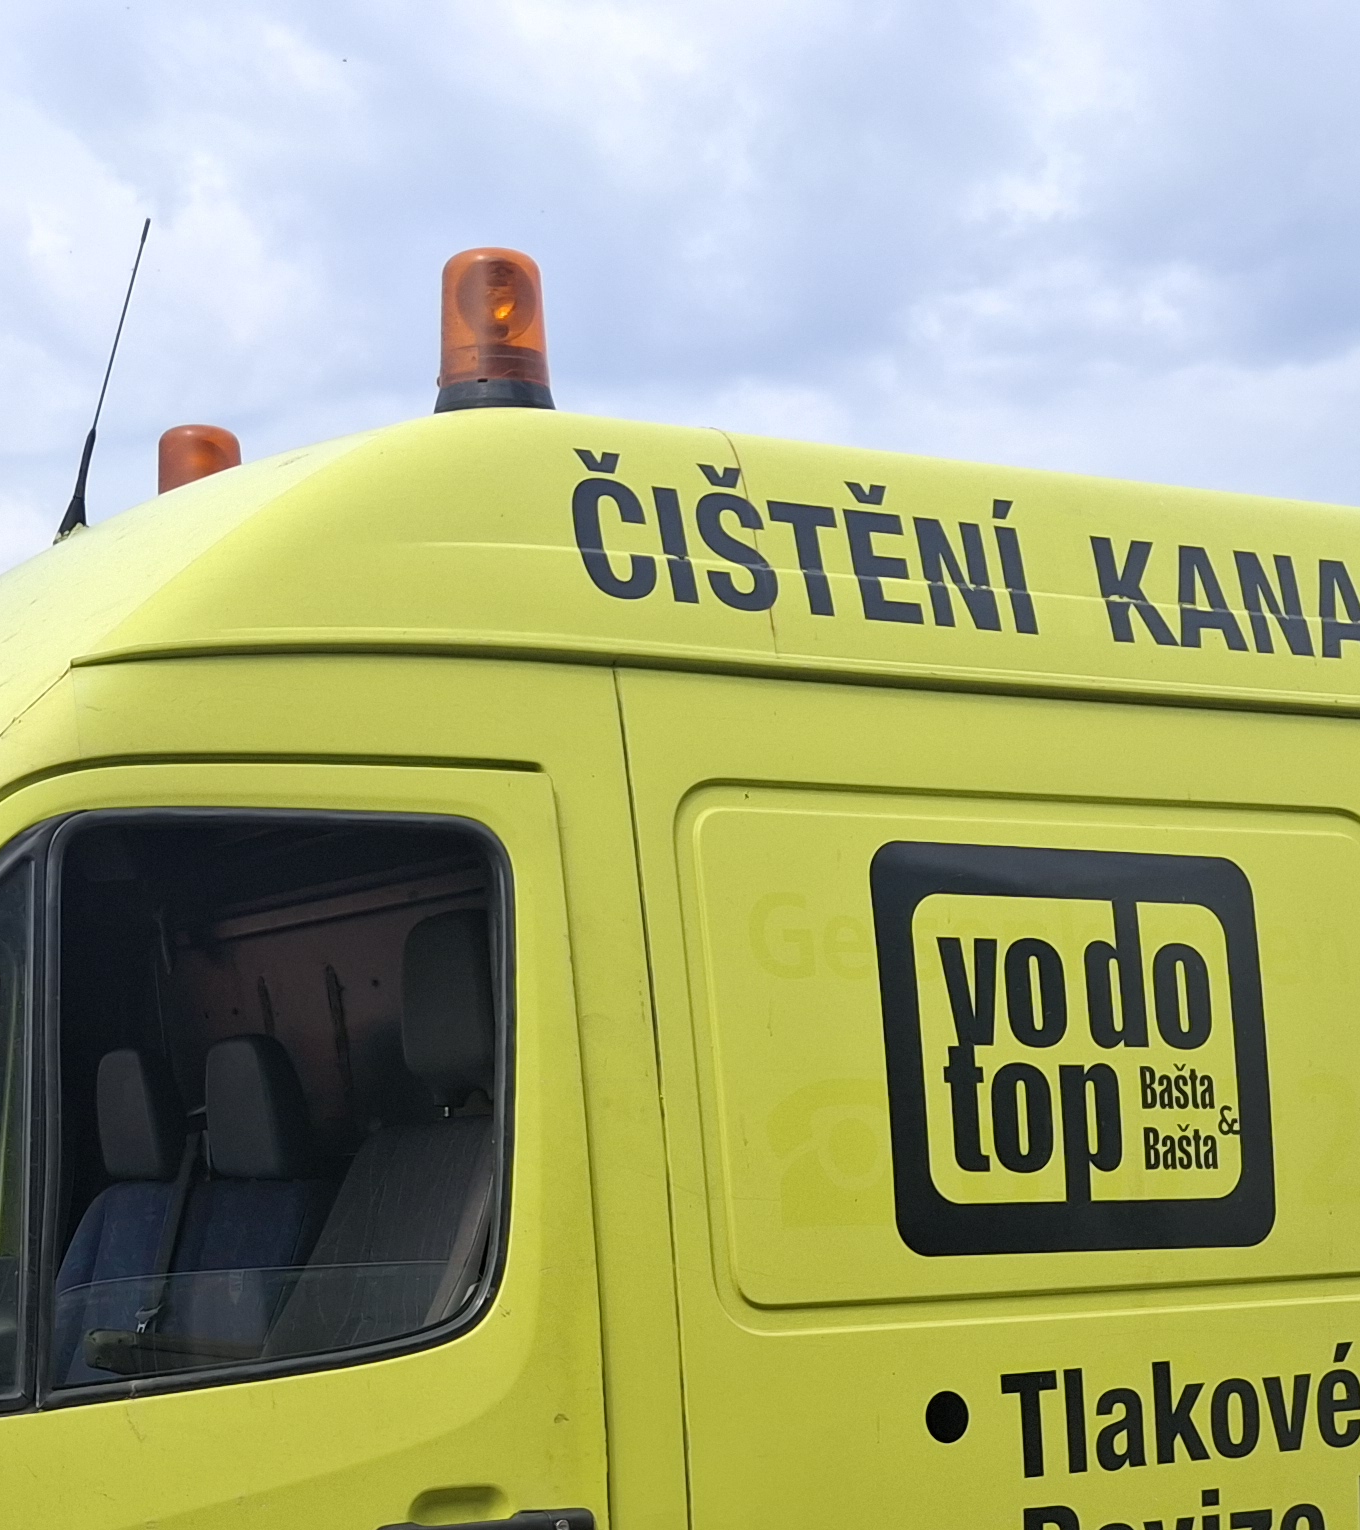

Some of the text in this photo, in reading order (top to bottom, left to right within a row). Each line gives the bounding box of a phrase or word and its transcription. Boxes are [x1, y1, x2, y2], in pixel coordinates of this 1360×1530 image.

[571, 448, 1039, 635] ČIŠTĚNÍ
[943, 1045, 1124, 1203] top
[1139, 1063, 1216, 1111] Bašta
[1143, 1123, 1220, 1172] Bašta
